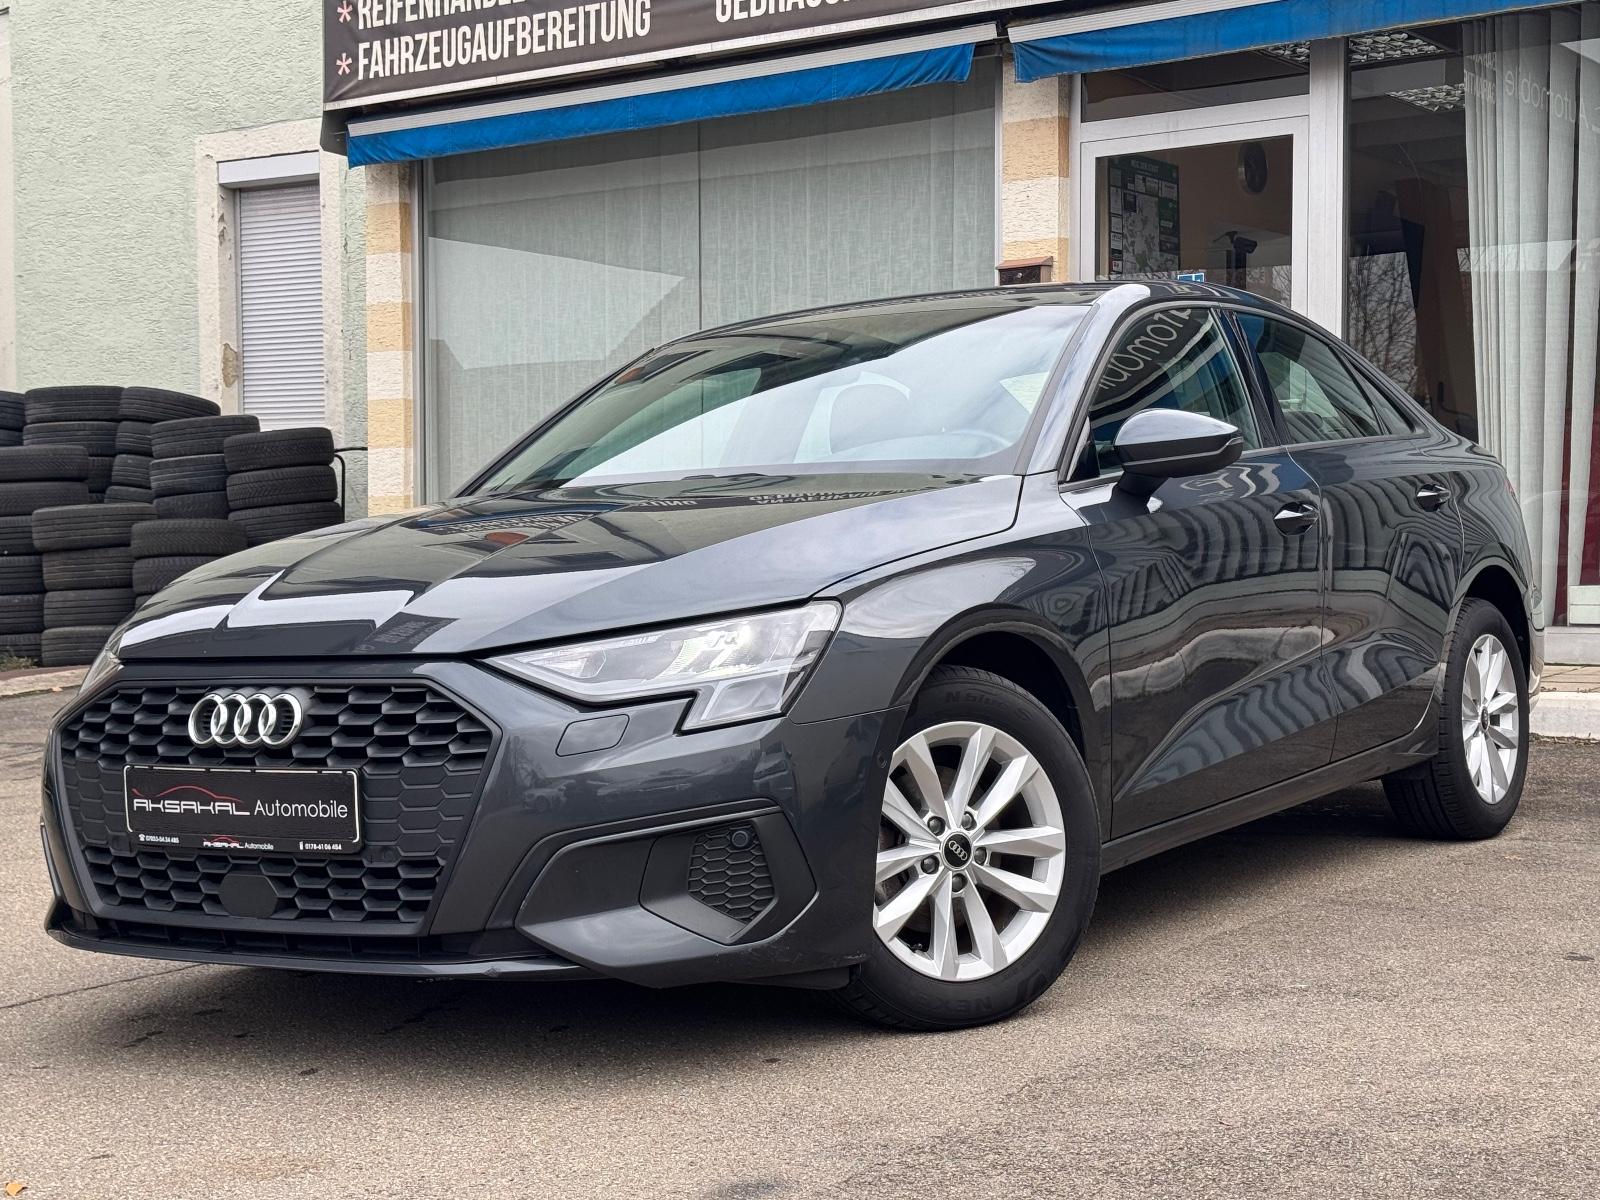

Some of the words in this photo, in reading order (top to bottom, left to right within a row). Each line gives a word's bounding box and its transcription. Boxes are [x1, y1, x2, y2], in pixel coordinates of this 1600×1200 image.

[357, 0, 651, 80] FAHRZEUGAUFBEREITUNG
[133, 799, 251, 816] AKSAKAL
[254, 799, 348, 818] Automobile
[244, 842, 274, 850] Automobile
